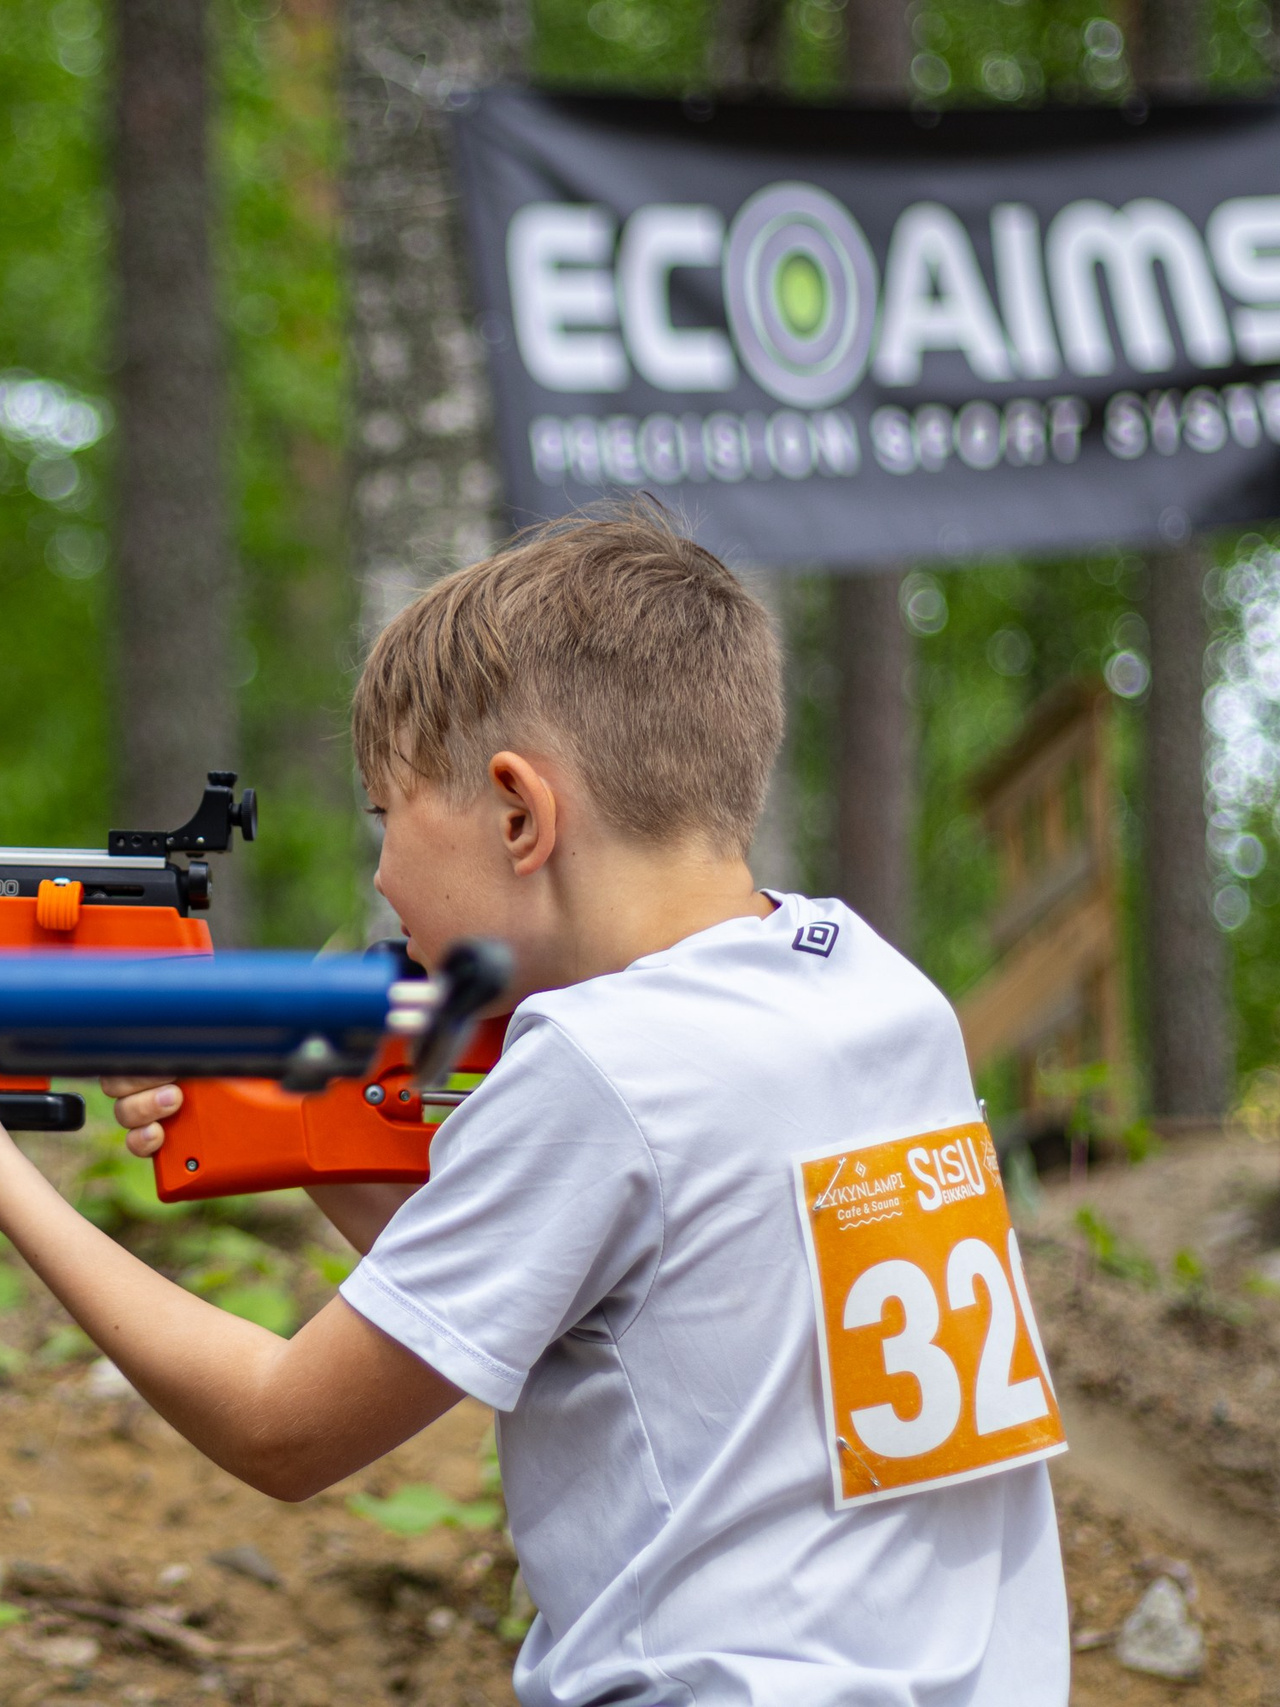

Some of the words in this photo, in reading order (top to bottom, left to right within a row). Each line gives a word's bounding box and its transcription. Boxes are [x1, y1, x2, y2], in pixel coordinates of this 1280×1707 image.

[506, 181, 1280, 409] ECOAIMS
[528, 410, 862, 487] PRECISION
[869, 395, 1089, 476] SPORT
[838, 1207, 861, 1220] Cafe
[863, 1203, 870, 1214] &
[872, 1197, 900, 1211] Sauna
[907, 1137, 986, 1211] SISU
[843, 1228, 1057, 1458] 32
